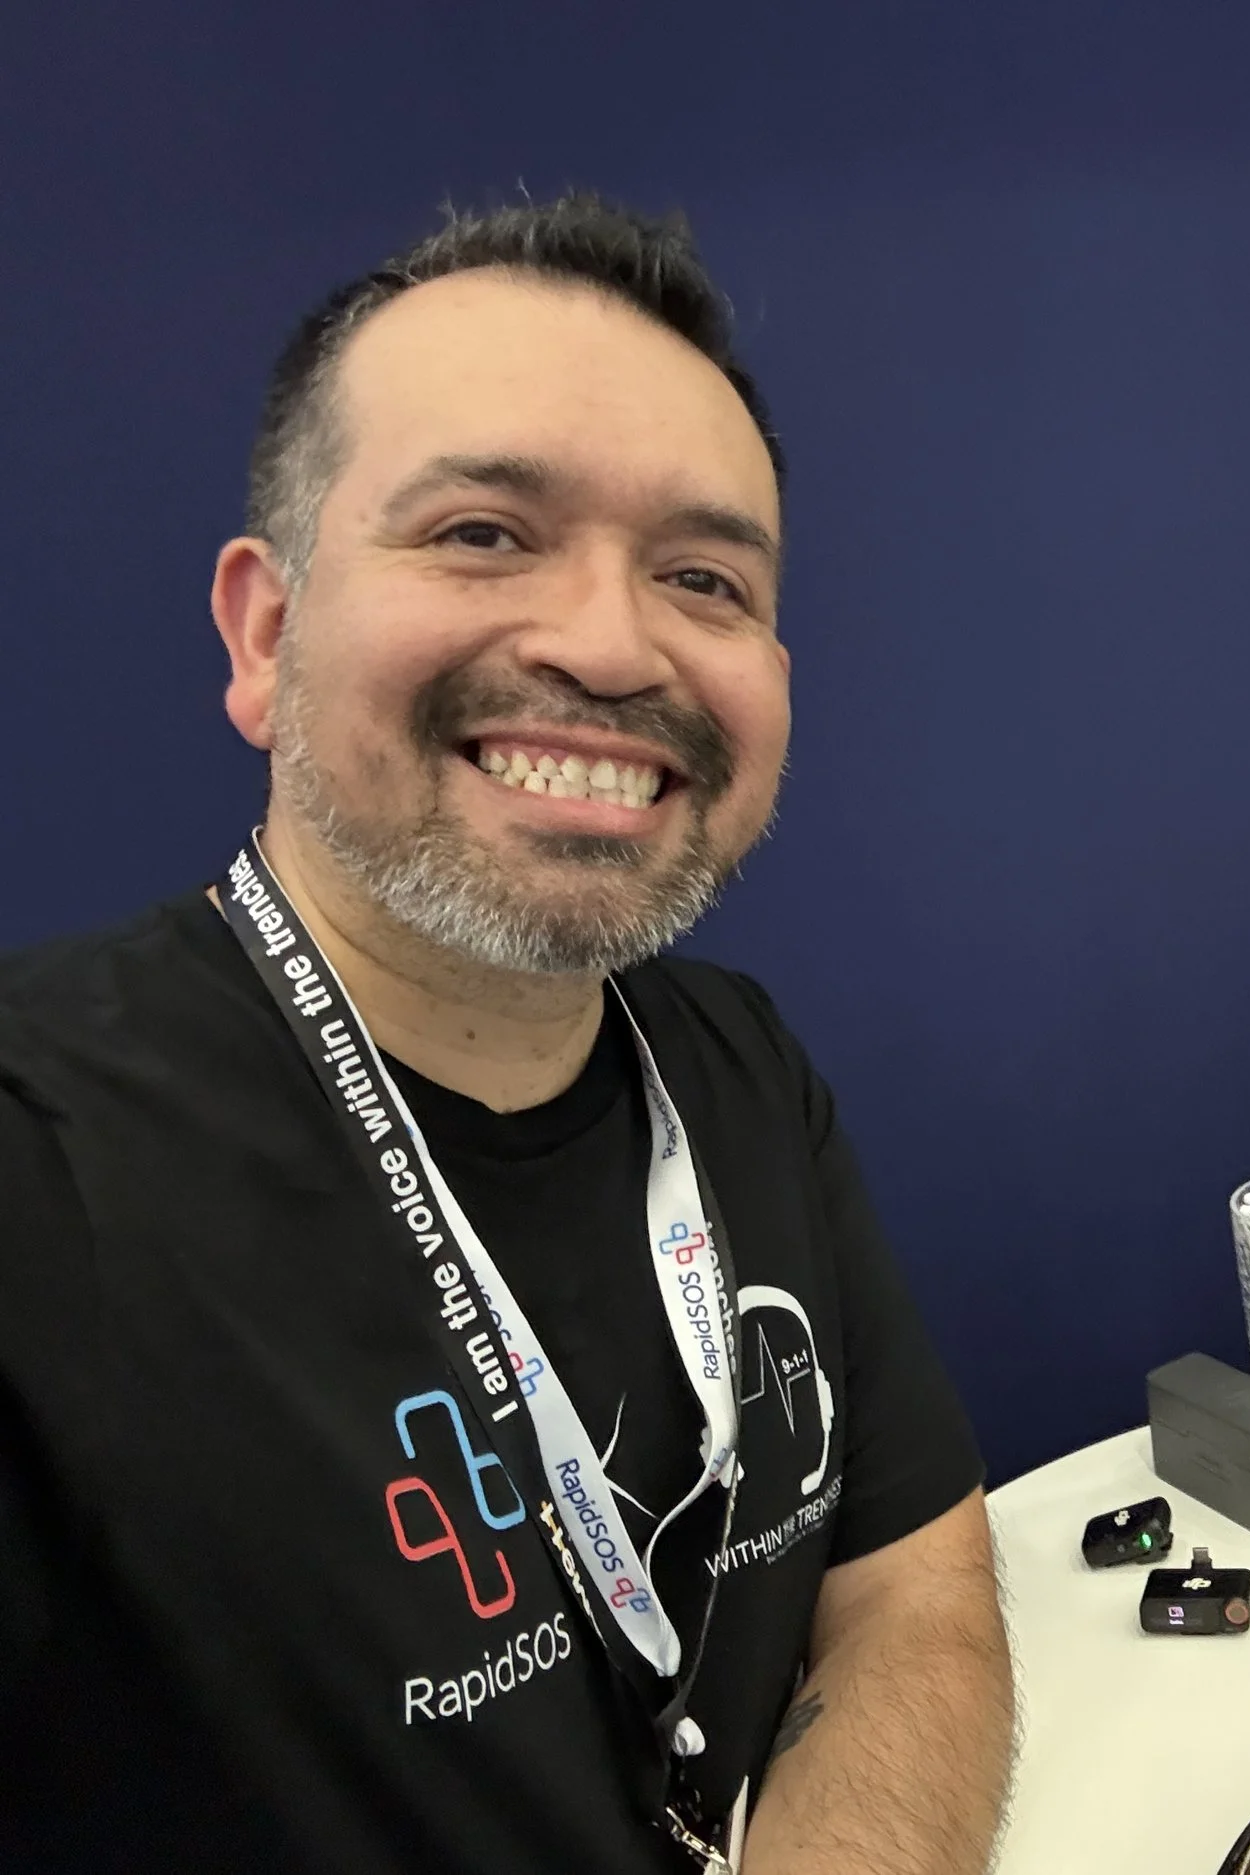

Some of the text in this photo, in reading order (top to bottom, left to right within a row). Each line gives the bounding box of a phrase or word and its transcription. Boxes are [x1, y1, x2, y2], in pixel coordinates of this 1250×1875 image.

[284, 954, 333, 1017] the
[319, 1019, 393, 1144] within
[380, 1147, 444, 1259] voice
[433, 1262, 479, 1331] the
[678, 1271, 721, 1380] RapidSOS
[466, 1332, 508, 1395] am
[781, 1349, 809, 1374] 9-1-1
[491, 1399, 519, 1422] I
[555, 1457, 626, 1574] RapidSOS
[704, 1524, 783, 1578] WITHIN
[404, 1612, 572, 1725] RapidSOS
